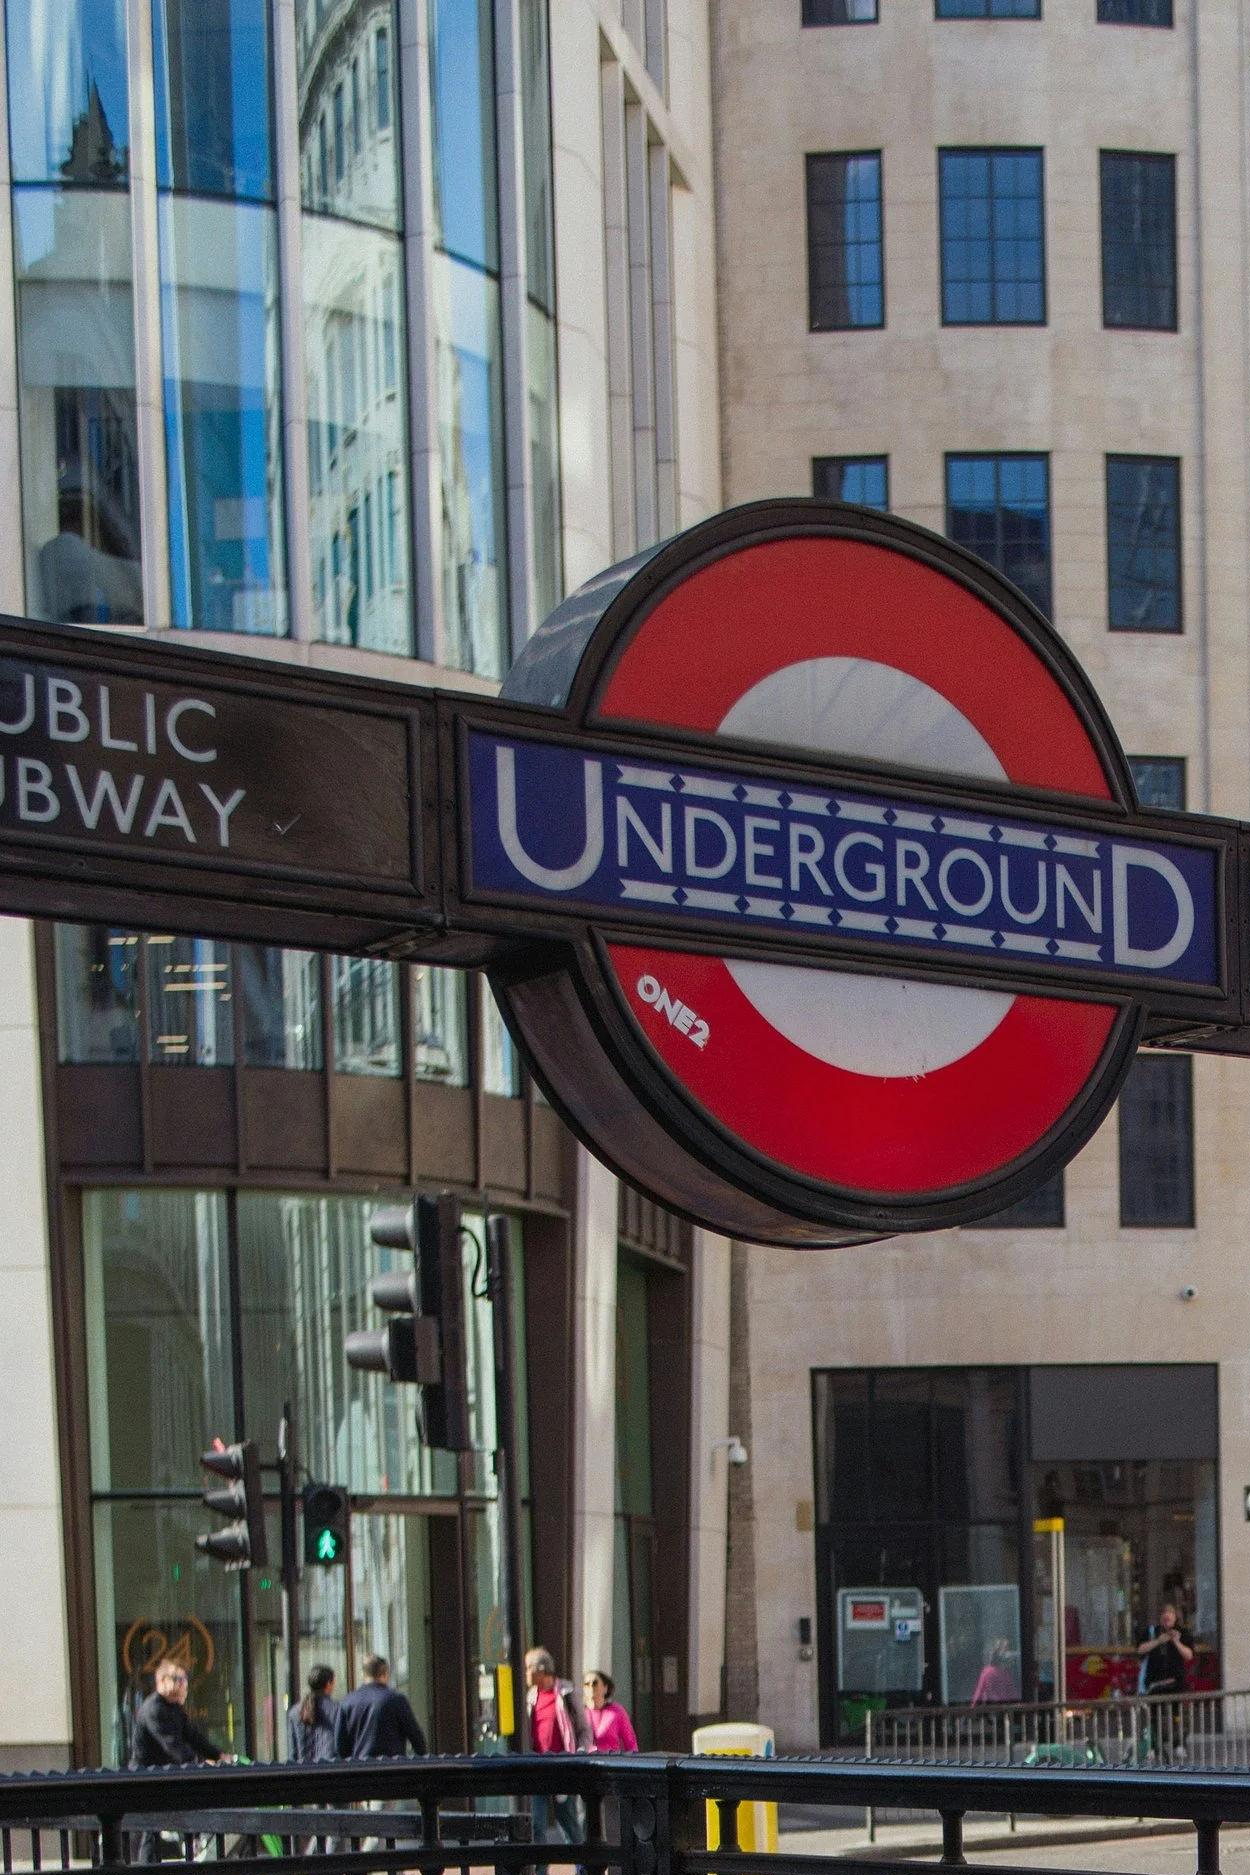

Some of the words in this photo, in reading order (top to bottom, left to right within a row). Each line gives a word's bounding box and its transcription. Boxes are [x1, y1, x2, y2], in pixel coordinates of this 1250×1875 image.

[0, 755, 246, 848] BWAY
[496, 746, 1194, 969] UNDERGROUND
[637, 974, 710, 1050] ONE2
